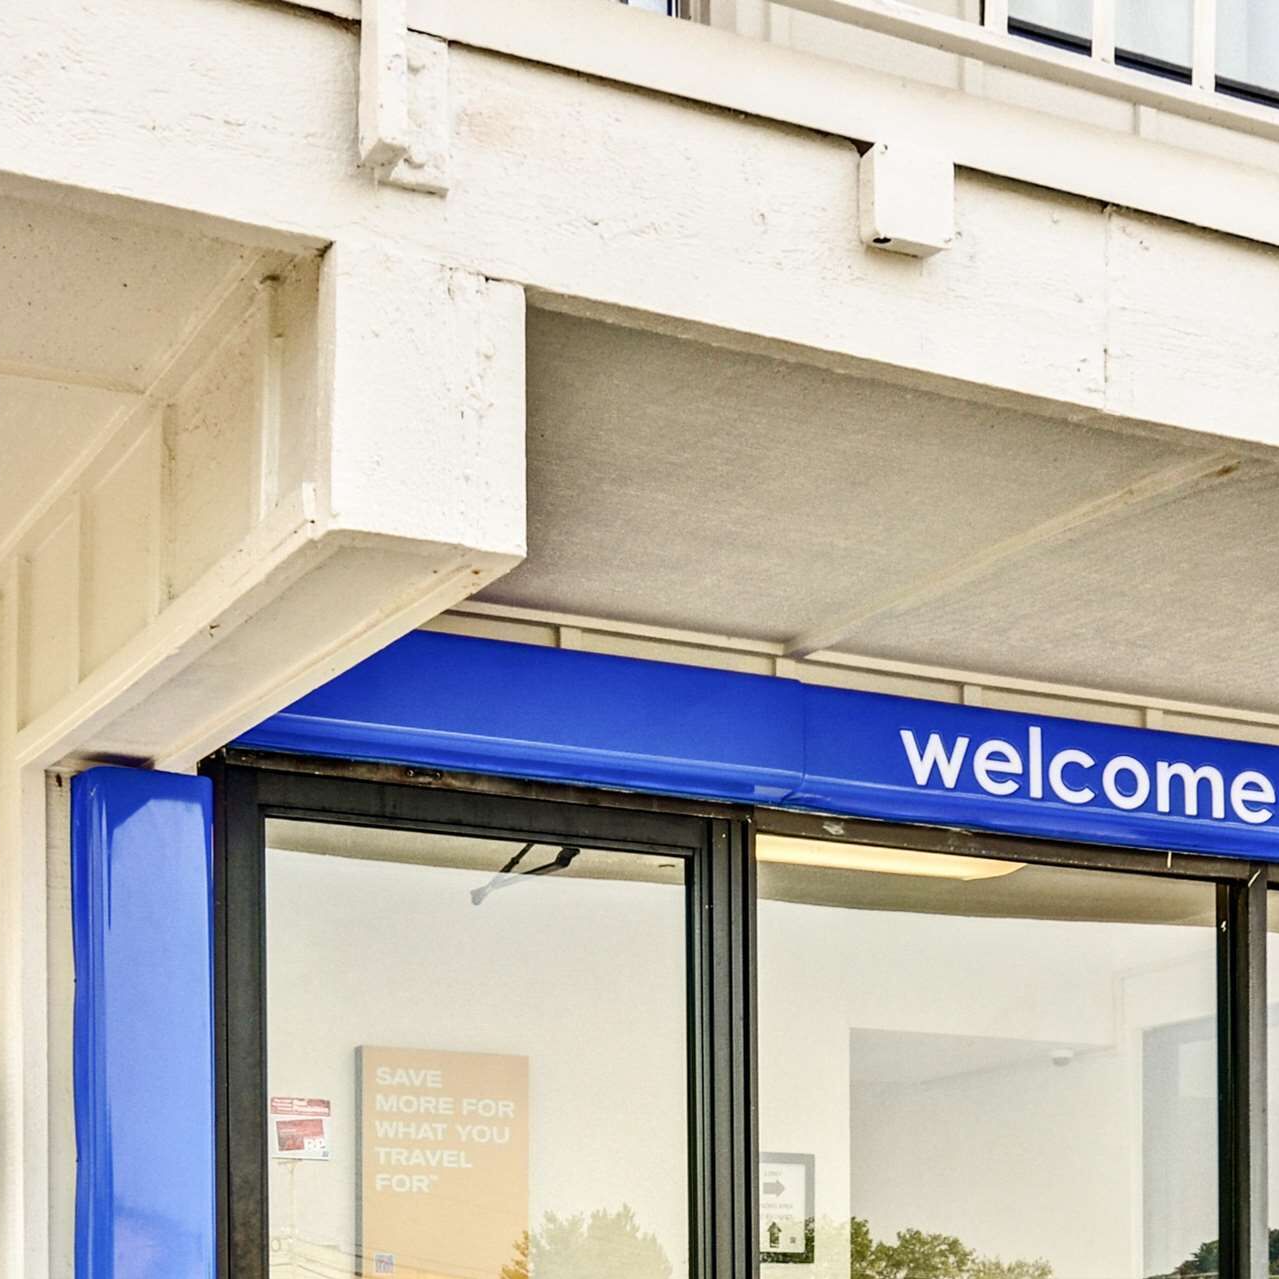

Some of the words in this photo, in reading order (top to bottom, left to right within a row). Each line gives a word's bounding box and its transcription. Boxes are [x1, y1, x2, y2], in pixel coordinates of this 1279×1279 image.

[899, 725, 1277, 825] welcome
[375, 1066, 443, 1089] SAVE
[375, 1093, 454, 1115] MORE
[462, 1097, 515, 1119] FOR
[374, 1119, 448, 1141] WHAT
[455, 1124, 511, 1144] YOU
[373, 1146, 473, 1169] TRAVEL
